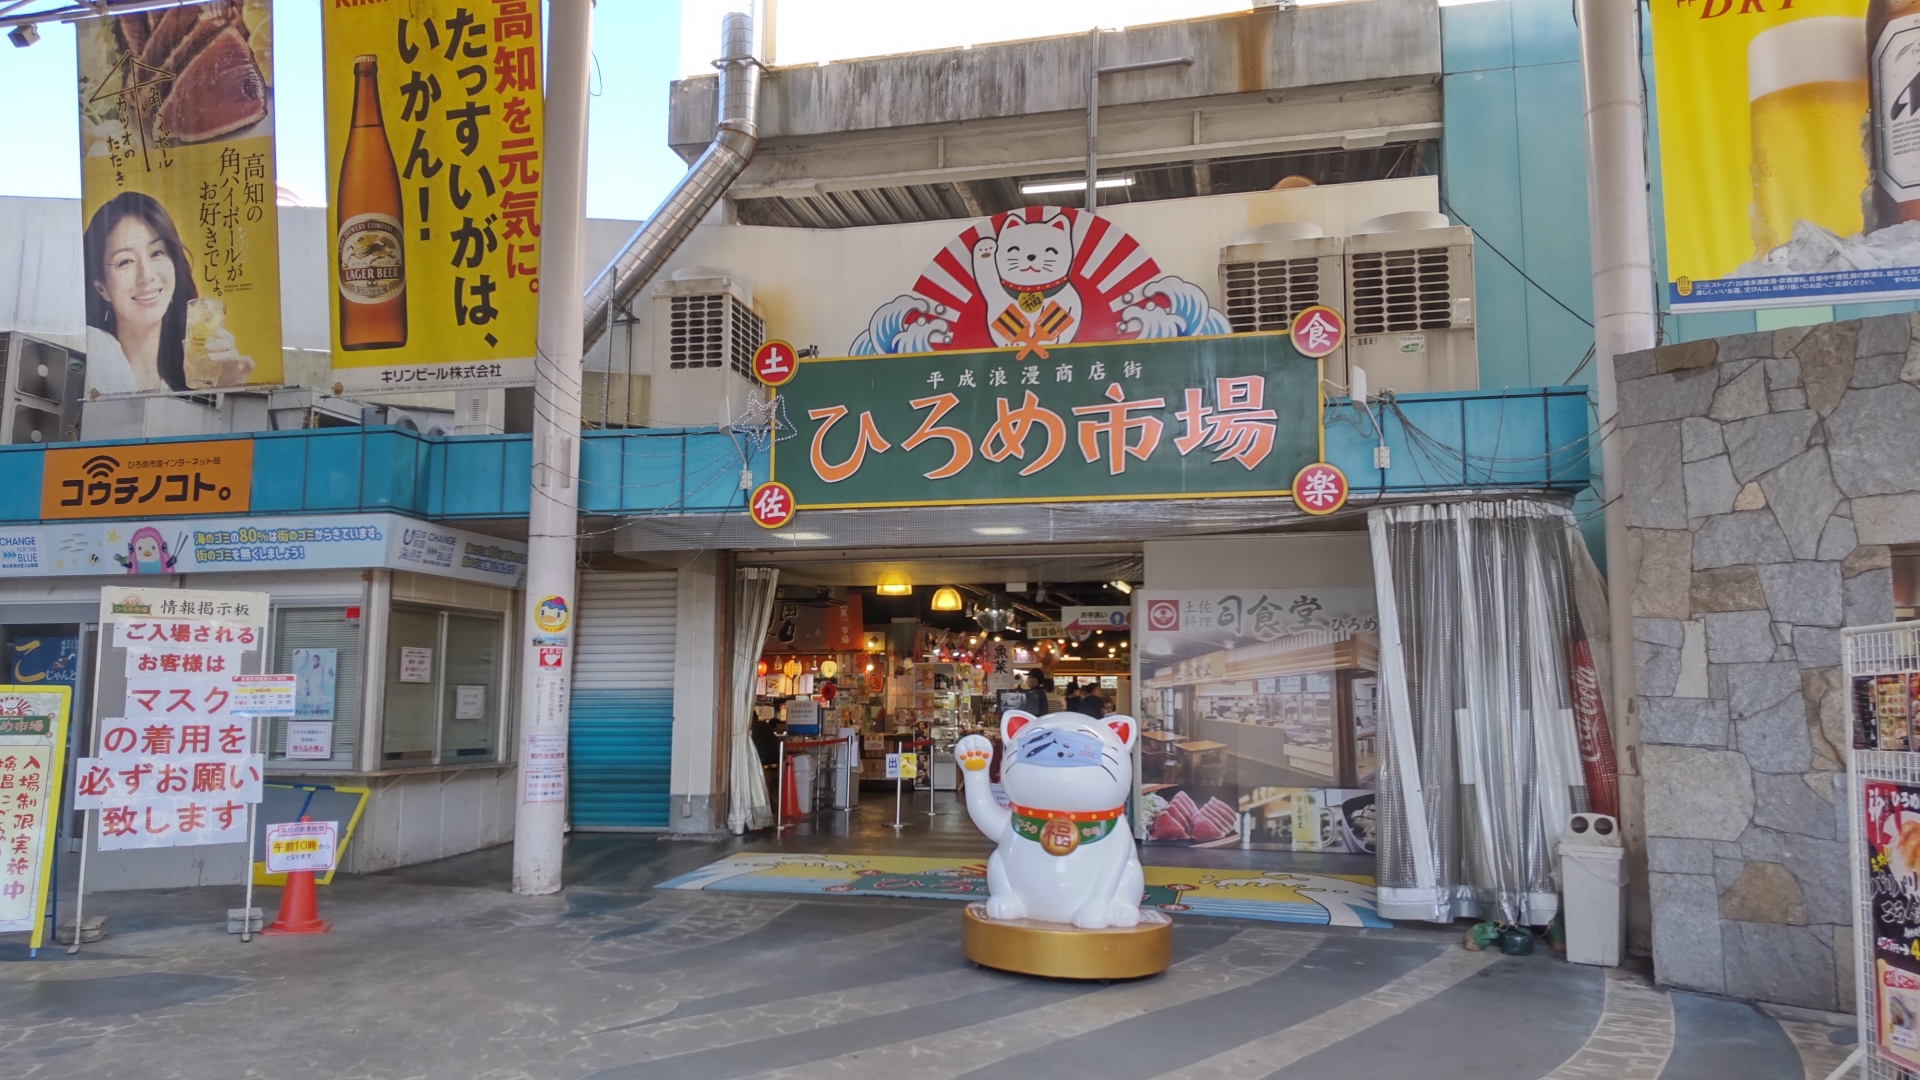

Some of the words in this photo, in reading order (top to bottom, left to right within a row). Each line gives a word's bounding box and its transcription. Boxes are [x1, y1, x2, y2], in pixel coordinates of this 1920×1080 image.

[116, 96, 135, 159] カツオの
[397, 16, 444, 241] いかん！
[107, 136, 125, 187] たたき
[243, 153, 265, 223] 高知の
[443, 7, 499, 348] たっすいがは、
[219, 147, 243, 282] 角ハイボールが
[199, 181, 222, 297] お好きでしょ。
[345, 268, 374, 280] LAGER
[376, 267, 399, 278] BEER
[1298, 312, 1339, 350] 食
[381, 363, 502, 383] キリンビール株式会社
[760, 347, 789, 375] 土
[926, 360, 1143, 390] 平成浪漫商店街
[807, 375, 1278, 483] ひろめ市場
[127, 456, 222, 469] ひろめ市場インターネット局
[60, 472, 232, 507] コウチノコト。
[1302, 470, 1339, 506] 楽
[754, 487, 788, 519] 佐
[0, 536, 36, 546] CHANGE
[194, 526, 382, 546] 海のゴミの80%は街のゴミからきています。
[17, 553, 38, 562] BLUE
[196, 546, 305, 562] 街のゴミを無くしましょう！
[160, 599, 250, 616] 情報掲示板
[1080, 611, 1108, 619] お手洗い
[1183, 600, 1213, 614] 土佐
[1217, 594, 1326, 635] 司食堂
[1331, 617, 1378, 633] ひろめ
[126, 623, 255, 644] ご入場される
[1182, 615, 1213, 629] 料理
[137, 653, 225, 673] お客様は
[131, 685, 229, 714] マスク
[103, 723, 247, 755] の着用を
[888, 757, 898, 769] 出
[78, 761, 260, 796] 必ずお願い
[3, 755, 41, 900] 入場制限実施中
[102, 800, 245, 837] 致します
[1016, 819, 1038, 835] ひろめ
[273, 840, 331, 853] 午前10時から
[1042, 821, 1072, 849] 福
